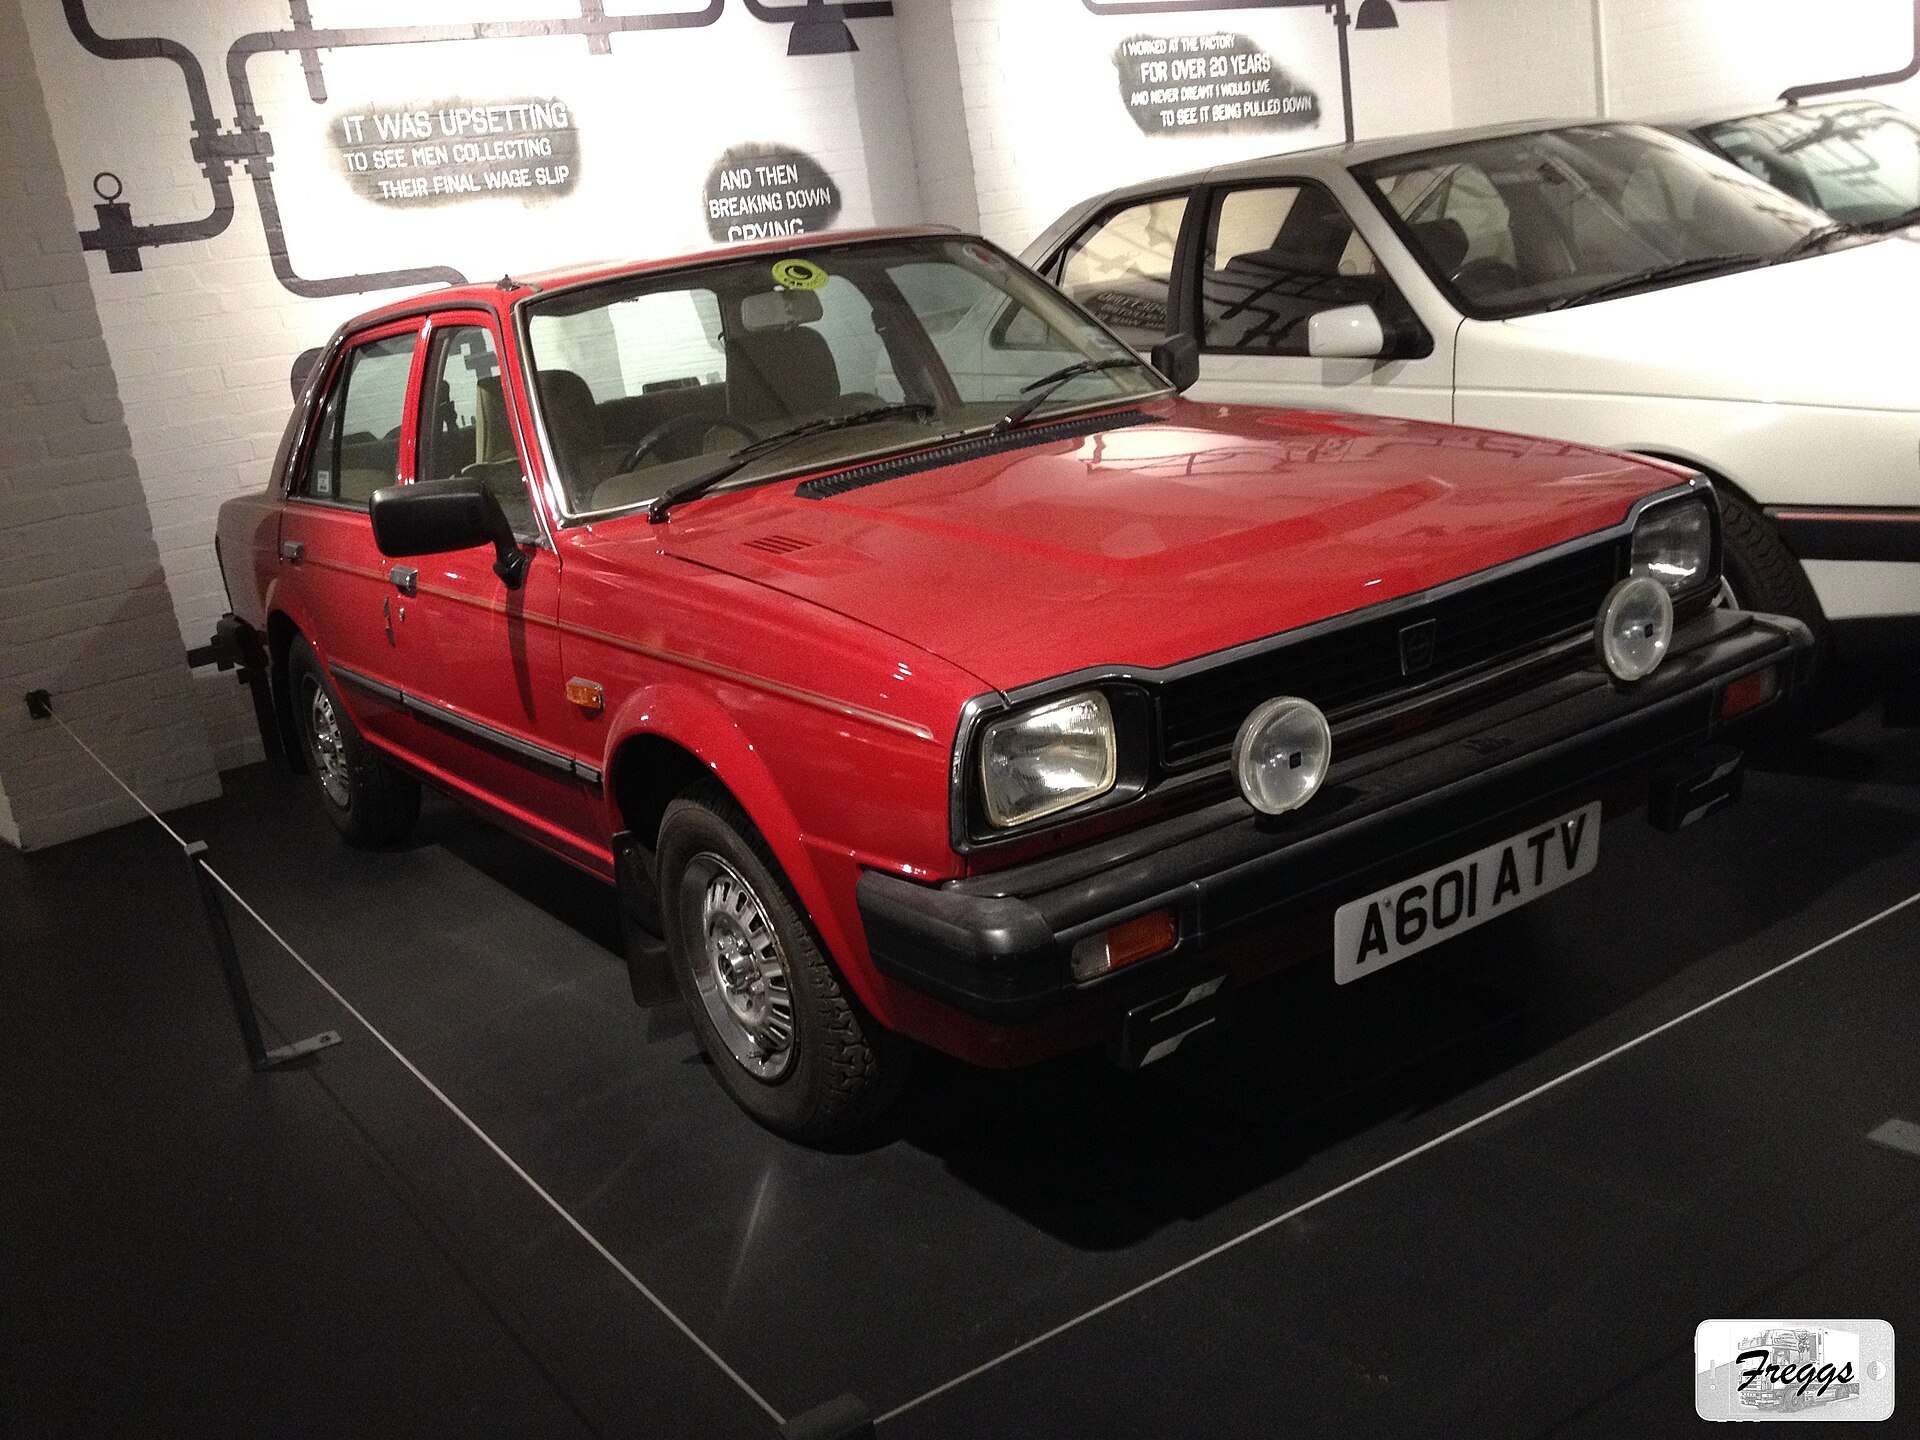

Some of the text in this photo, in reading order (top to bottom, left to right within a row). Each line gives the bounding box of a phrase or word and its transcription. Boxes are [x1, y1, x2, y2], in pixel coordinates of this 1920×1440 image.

[1123, 34, 1235, 56] I WORKED AT THE FACTORY
[1141, 54, 1271, 83] FOR OVER 20 YEARS
[1131, 79, 1271, 106] AND NEVER DREAMT I WOULD LIVE
[343, 103, 568, 143] IT WAS UPSETTING
[1160, 96, 1313, 127] TO SEE IT BEING PULLED DOWN
[343, 138, 552, 171] TO SEE MEN COLLECTING
[378, 165, 569, 199] THEIR FINAL WAGE SLIP
[720, 163, 799, 191] AND THEN
[709, 187, 831, 219] BREAKING DOWN
[1356, 813, 1586, 964] A601 ATV
